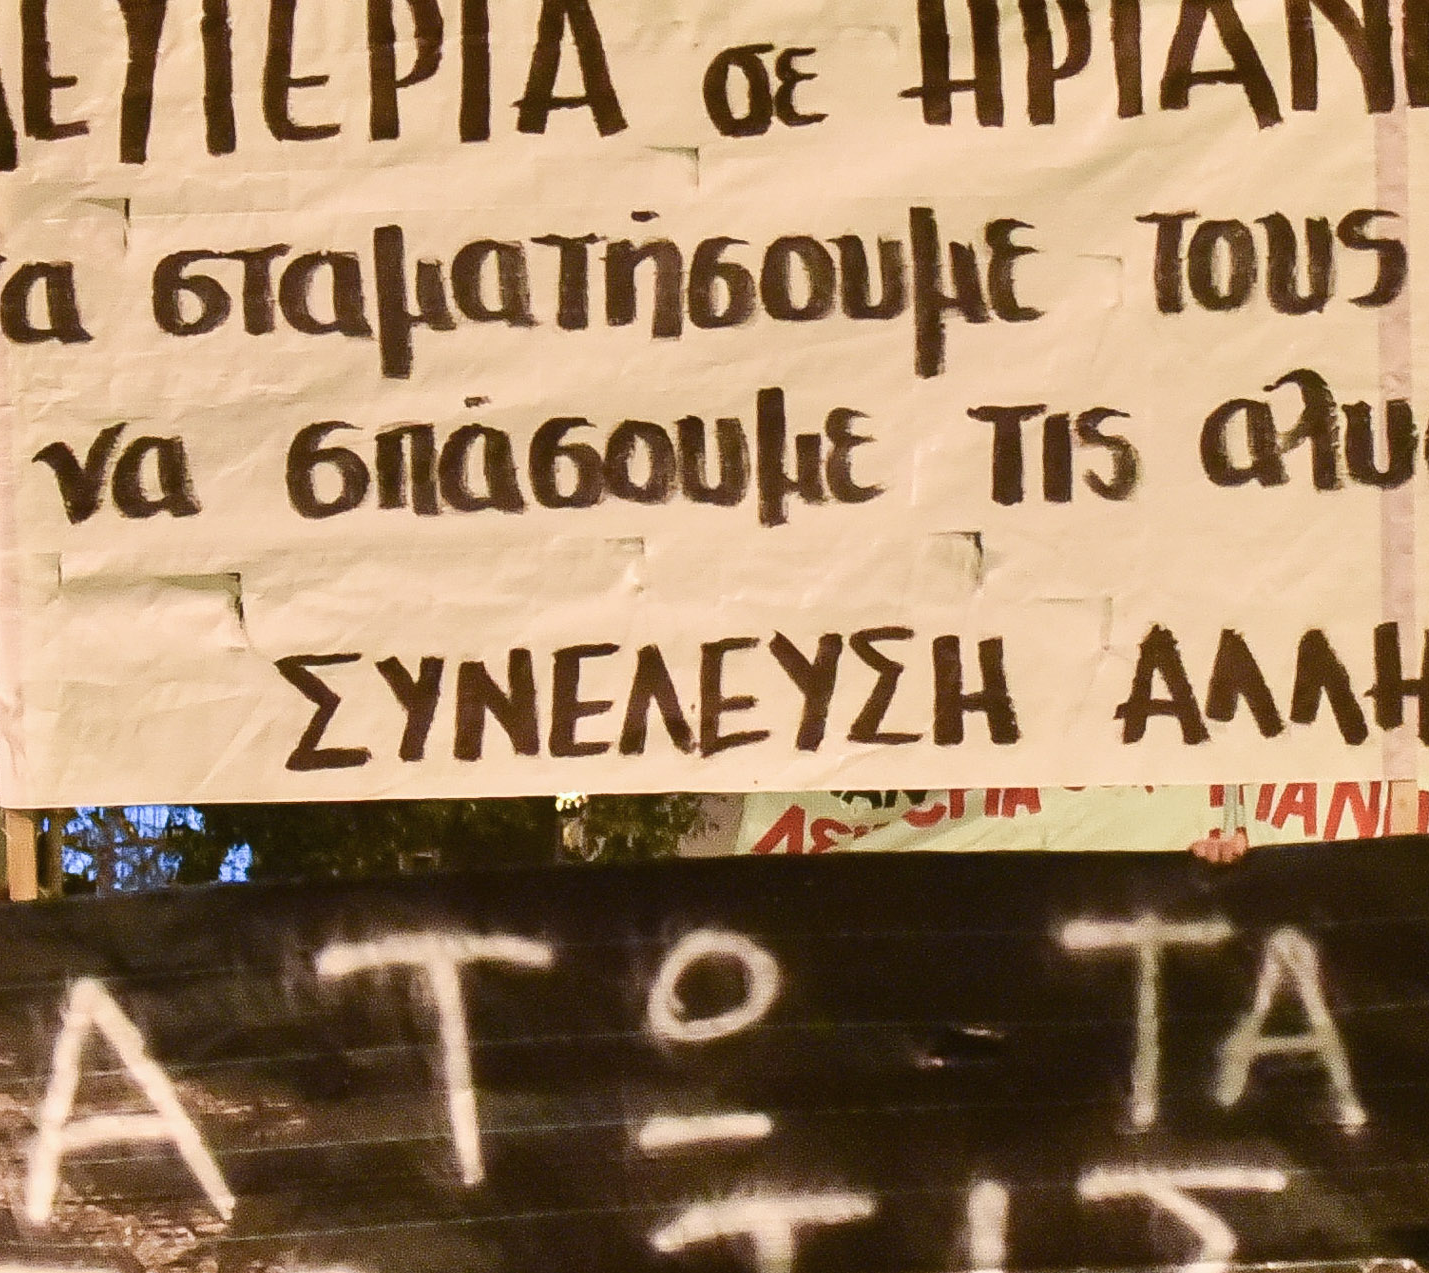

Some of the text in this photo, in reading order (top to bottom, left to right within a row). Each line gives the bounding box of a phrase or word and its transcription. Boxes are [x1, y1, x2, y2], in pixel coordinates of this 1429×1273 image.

[702, 42, 828, 137] σε
[31, 421, 204, 524] να
[274, 626, 1022, 772] ΣΥΝΕΛΕΥΣΗ
[1055, 916, 1370, 1136] ΤΑ
